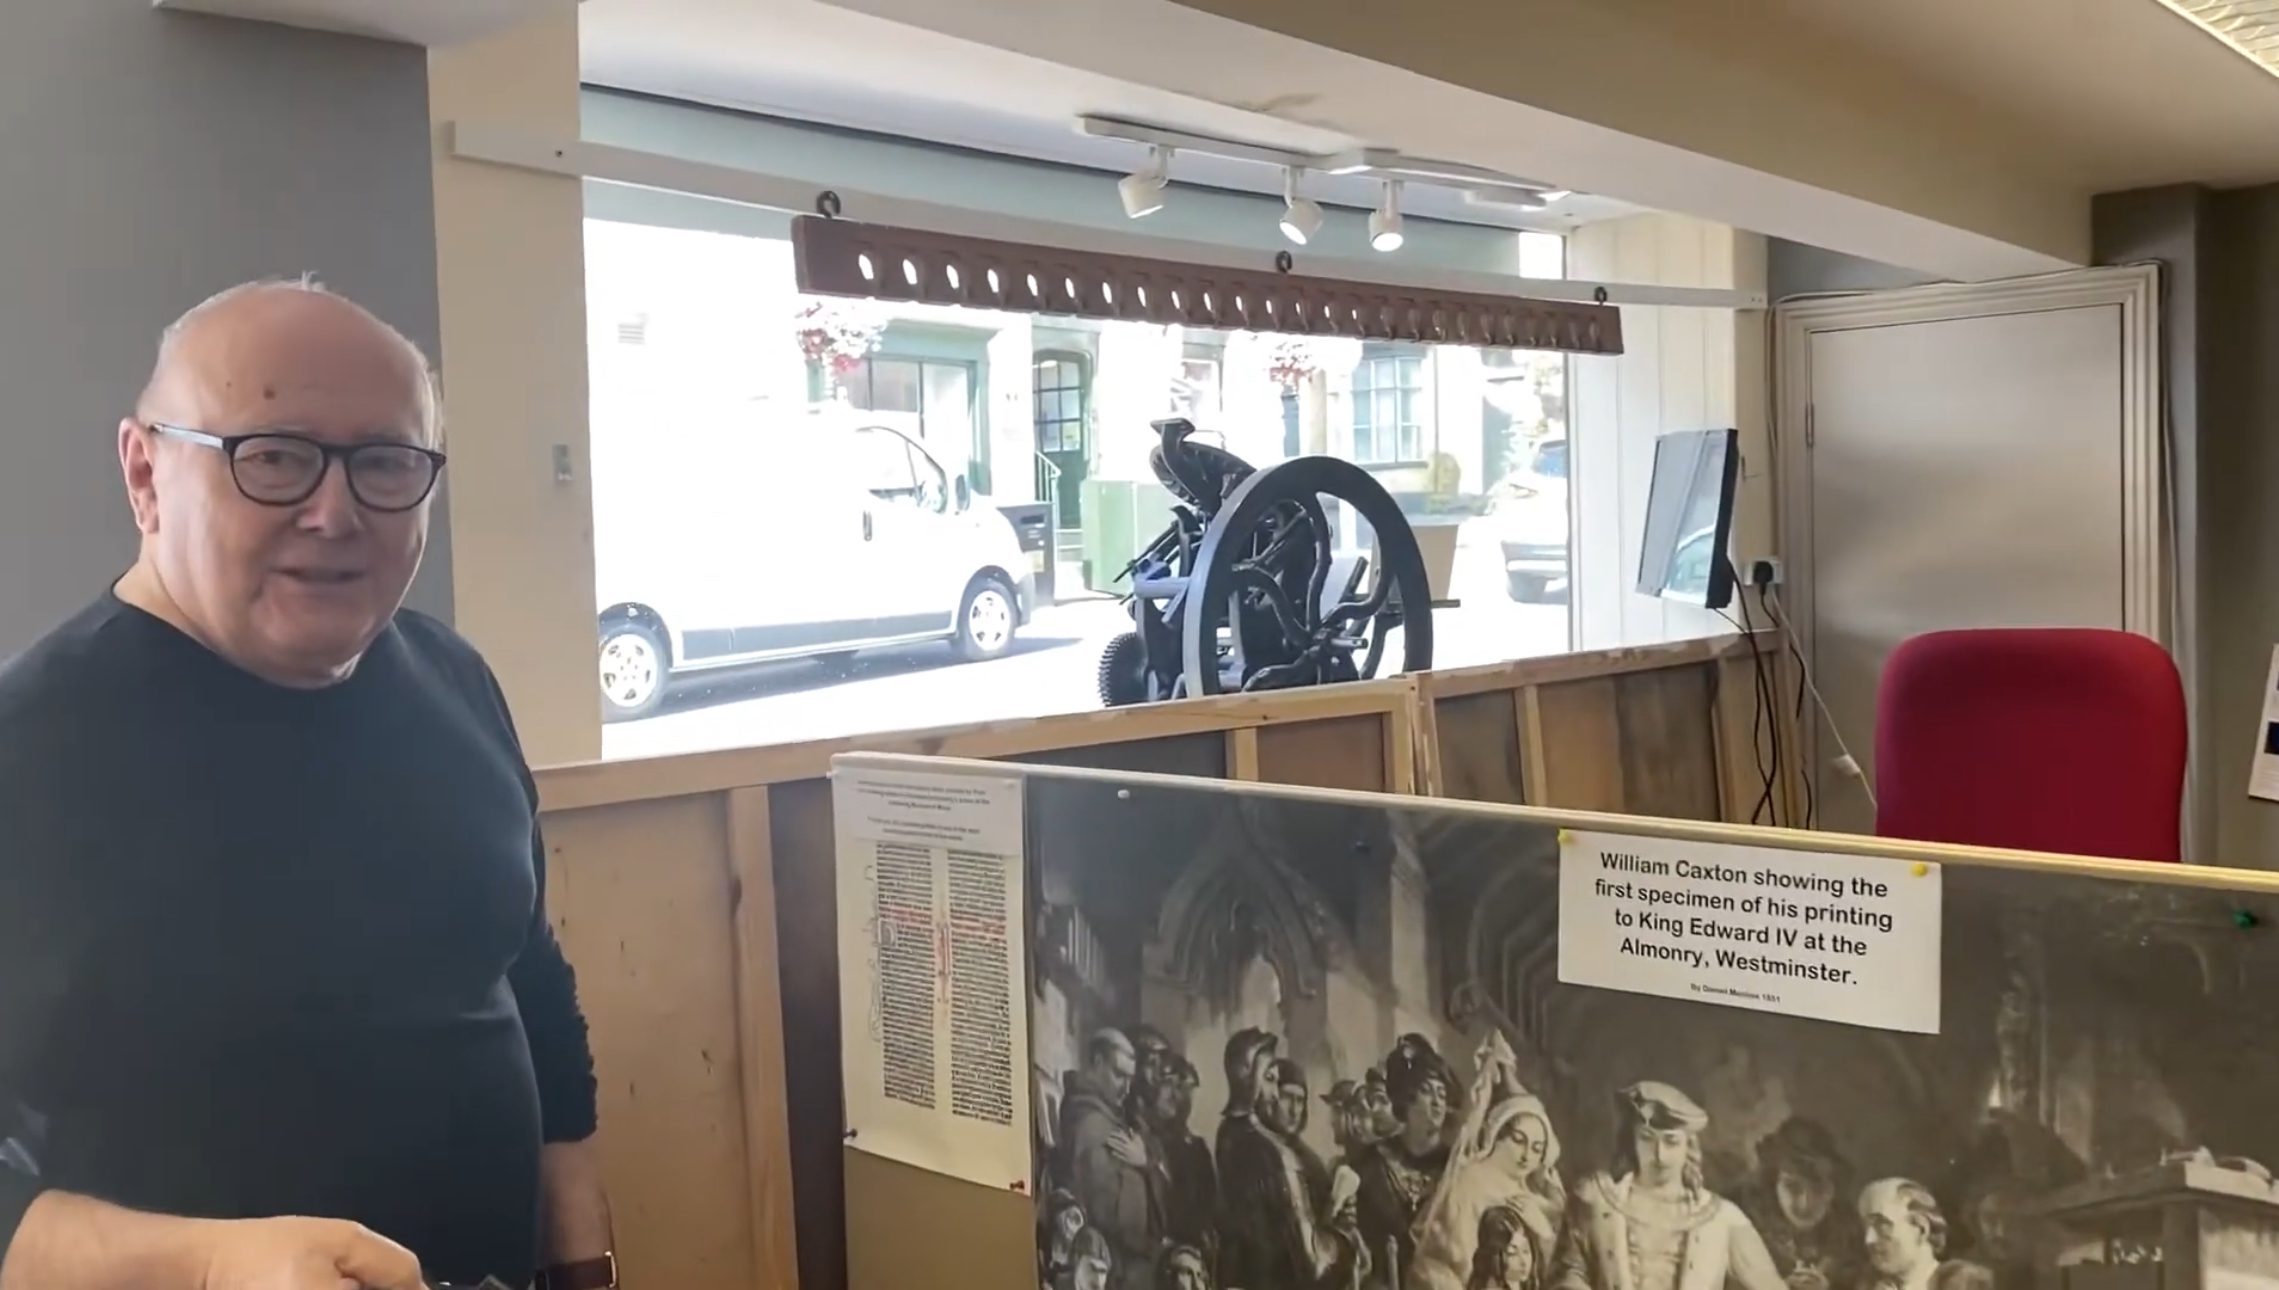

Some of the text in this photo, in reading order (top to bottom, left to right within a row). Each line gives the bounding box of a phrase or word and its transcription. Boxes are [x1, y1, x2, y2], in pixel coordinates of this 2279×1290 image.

[1600, 851, 1888, 899] William Caxton showing the
[1595, 878, 1893, 933] first specimen of his printing
[1615, 907, 1867, 956] to King Edward IV at the
[1620, 937, 1858, 985] Almonry, Westminster.
